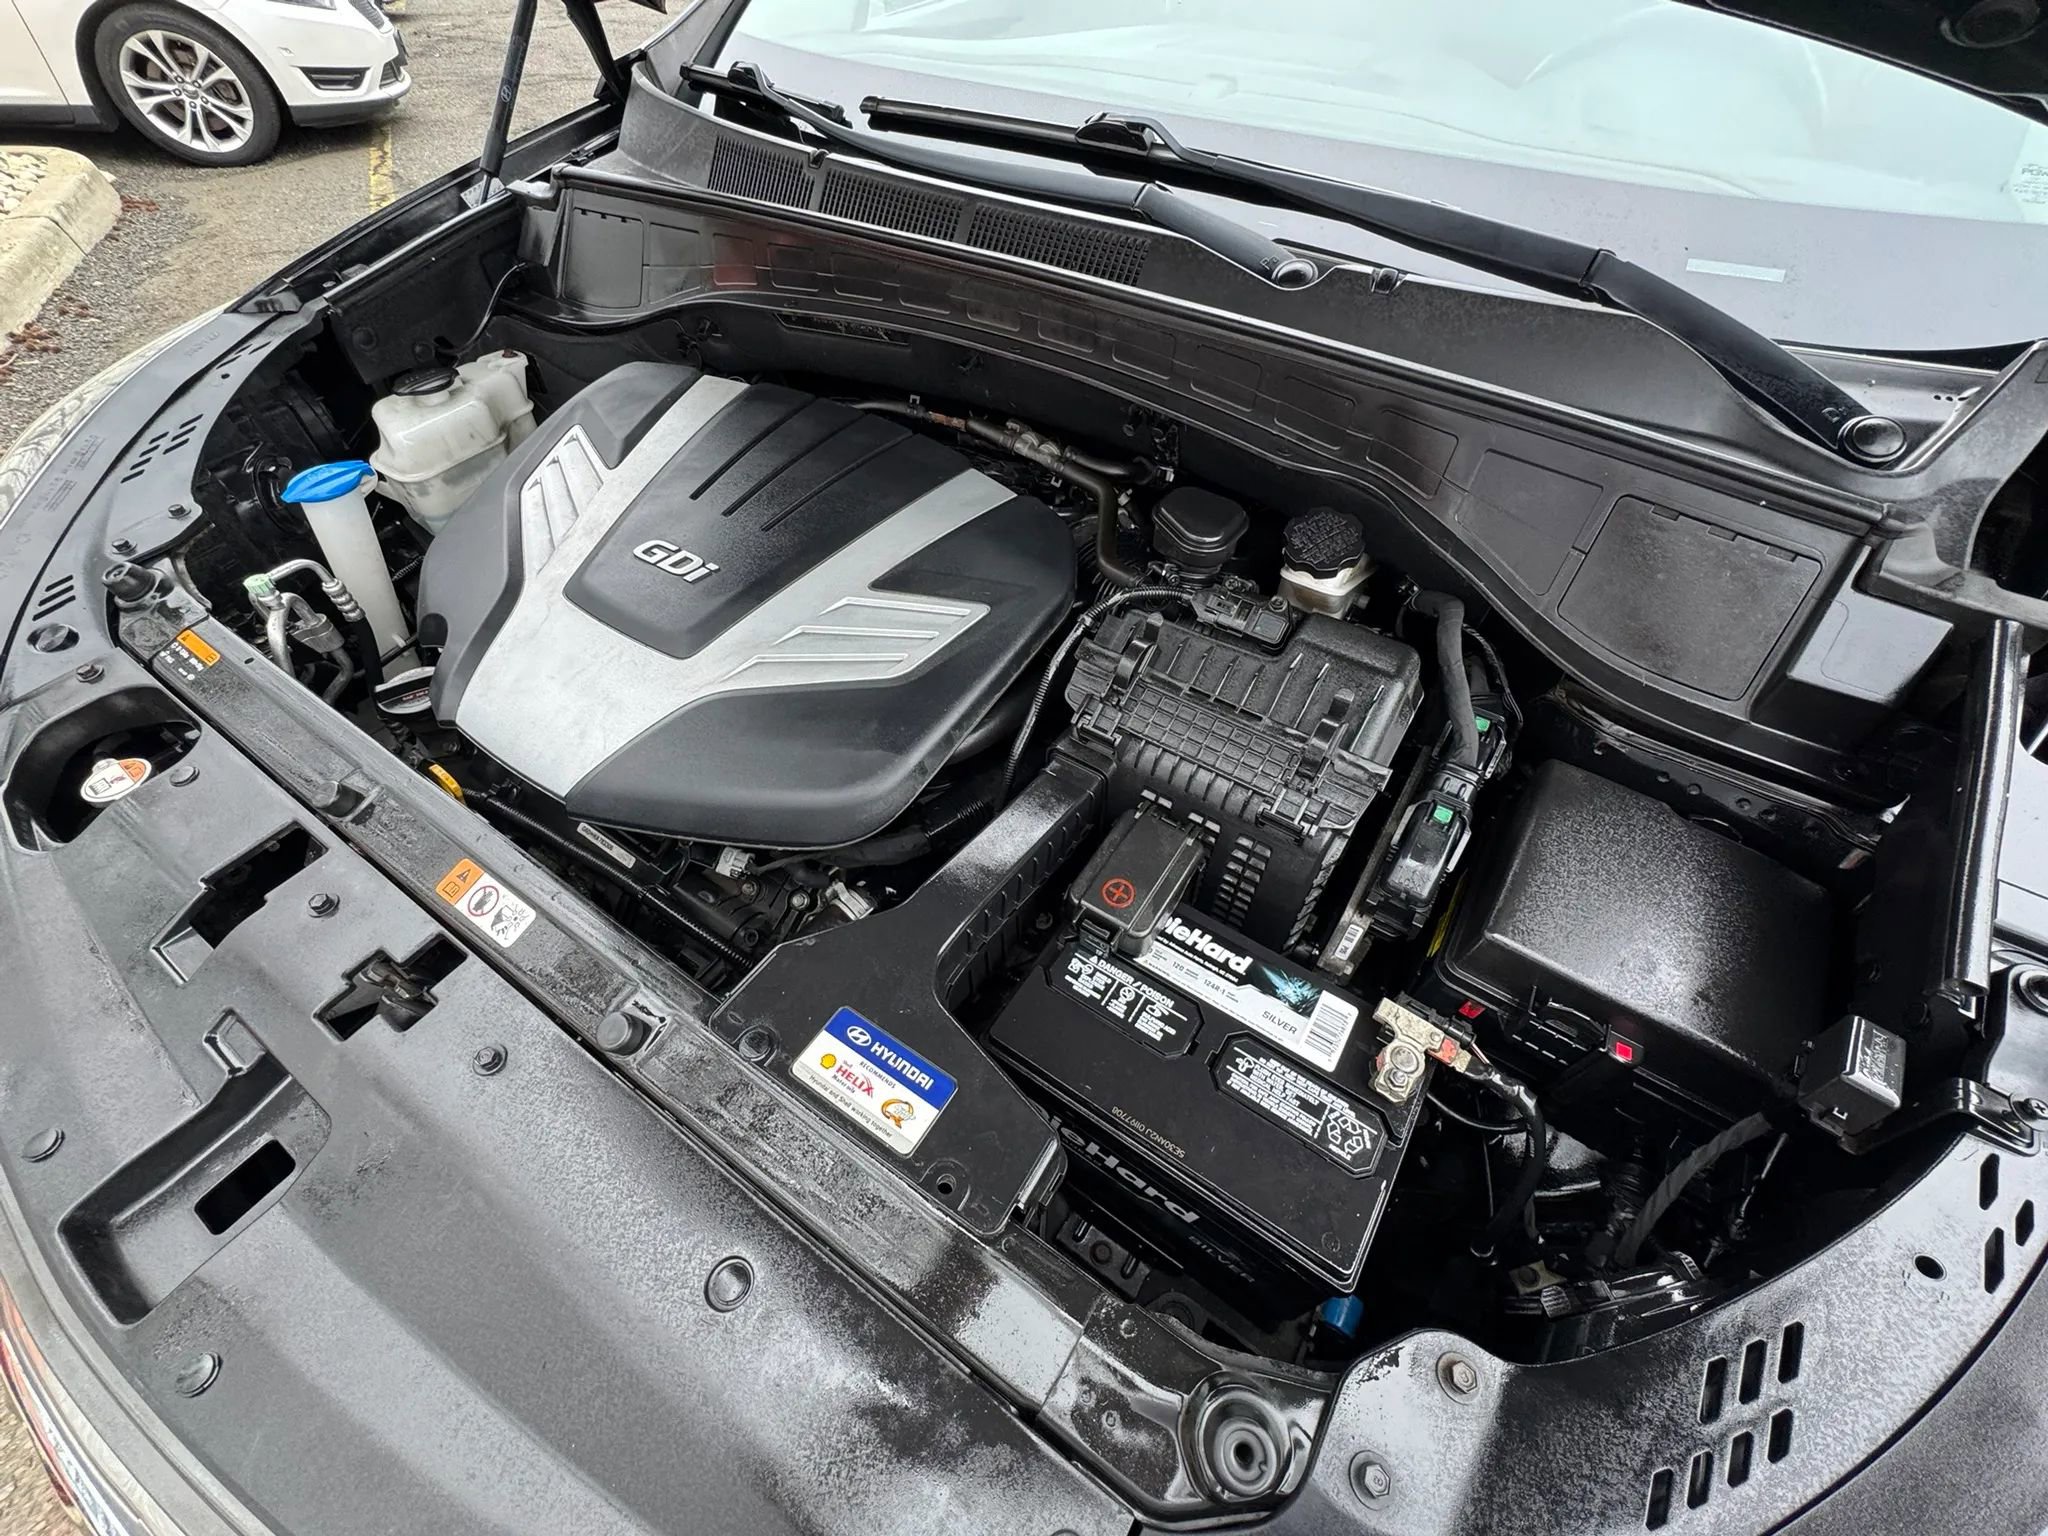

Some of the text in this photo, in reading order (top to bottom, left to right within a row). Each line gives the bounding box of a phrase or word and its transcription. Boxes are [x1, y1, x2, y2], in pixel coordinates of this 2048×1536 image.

[633, 540, 720, 584] GDi
[1098, 960, 1134, 985] DANGER
[1140, 984, 1175, 1008] POISON
[1262, 1010, 1298, 1035] SILVER
[836, 1065, 874, 1097] HELIX
[859, 1061, 896, 1089] RECOMMENDS
[870, 1042, 935, 1090] HYUNDAI
[809, 1075, 892, 1139] Hyundai and Shell working together
